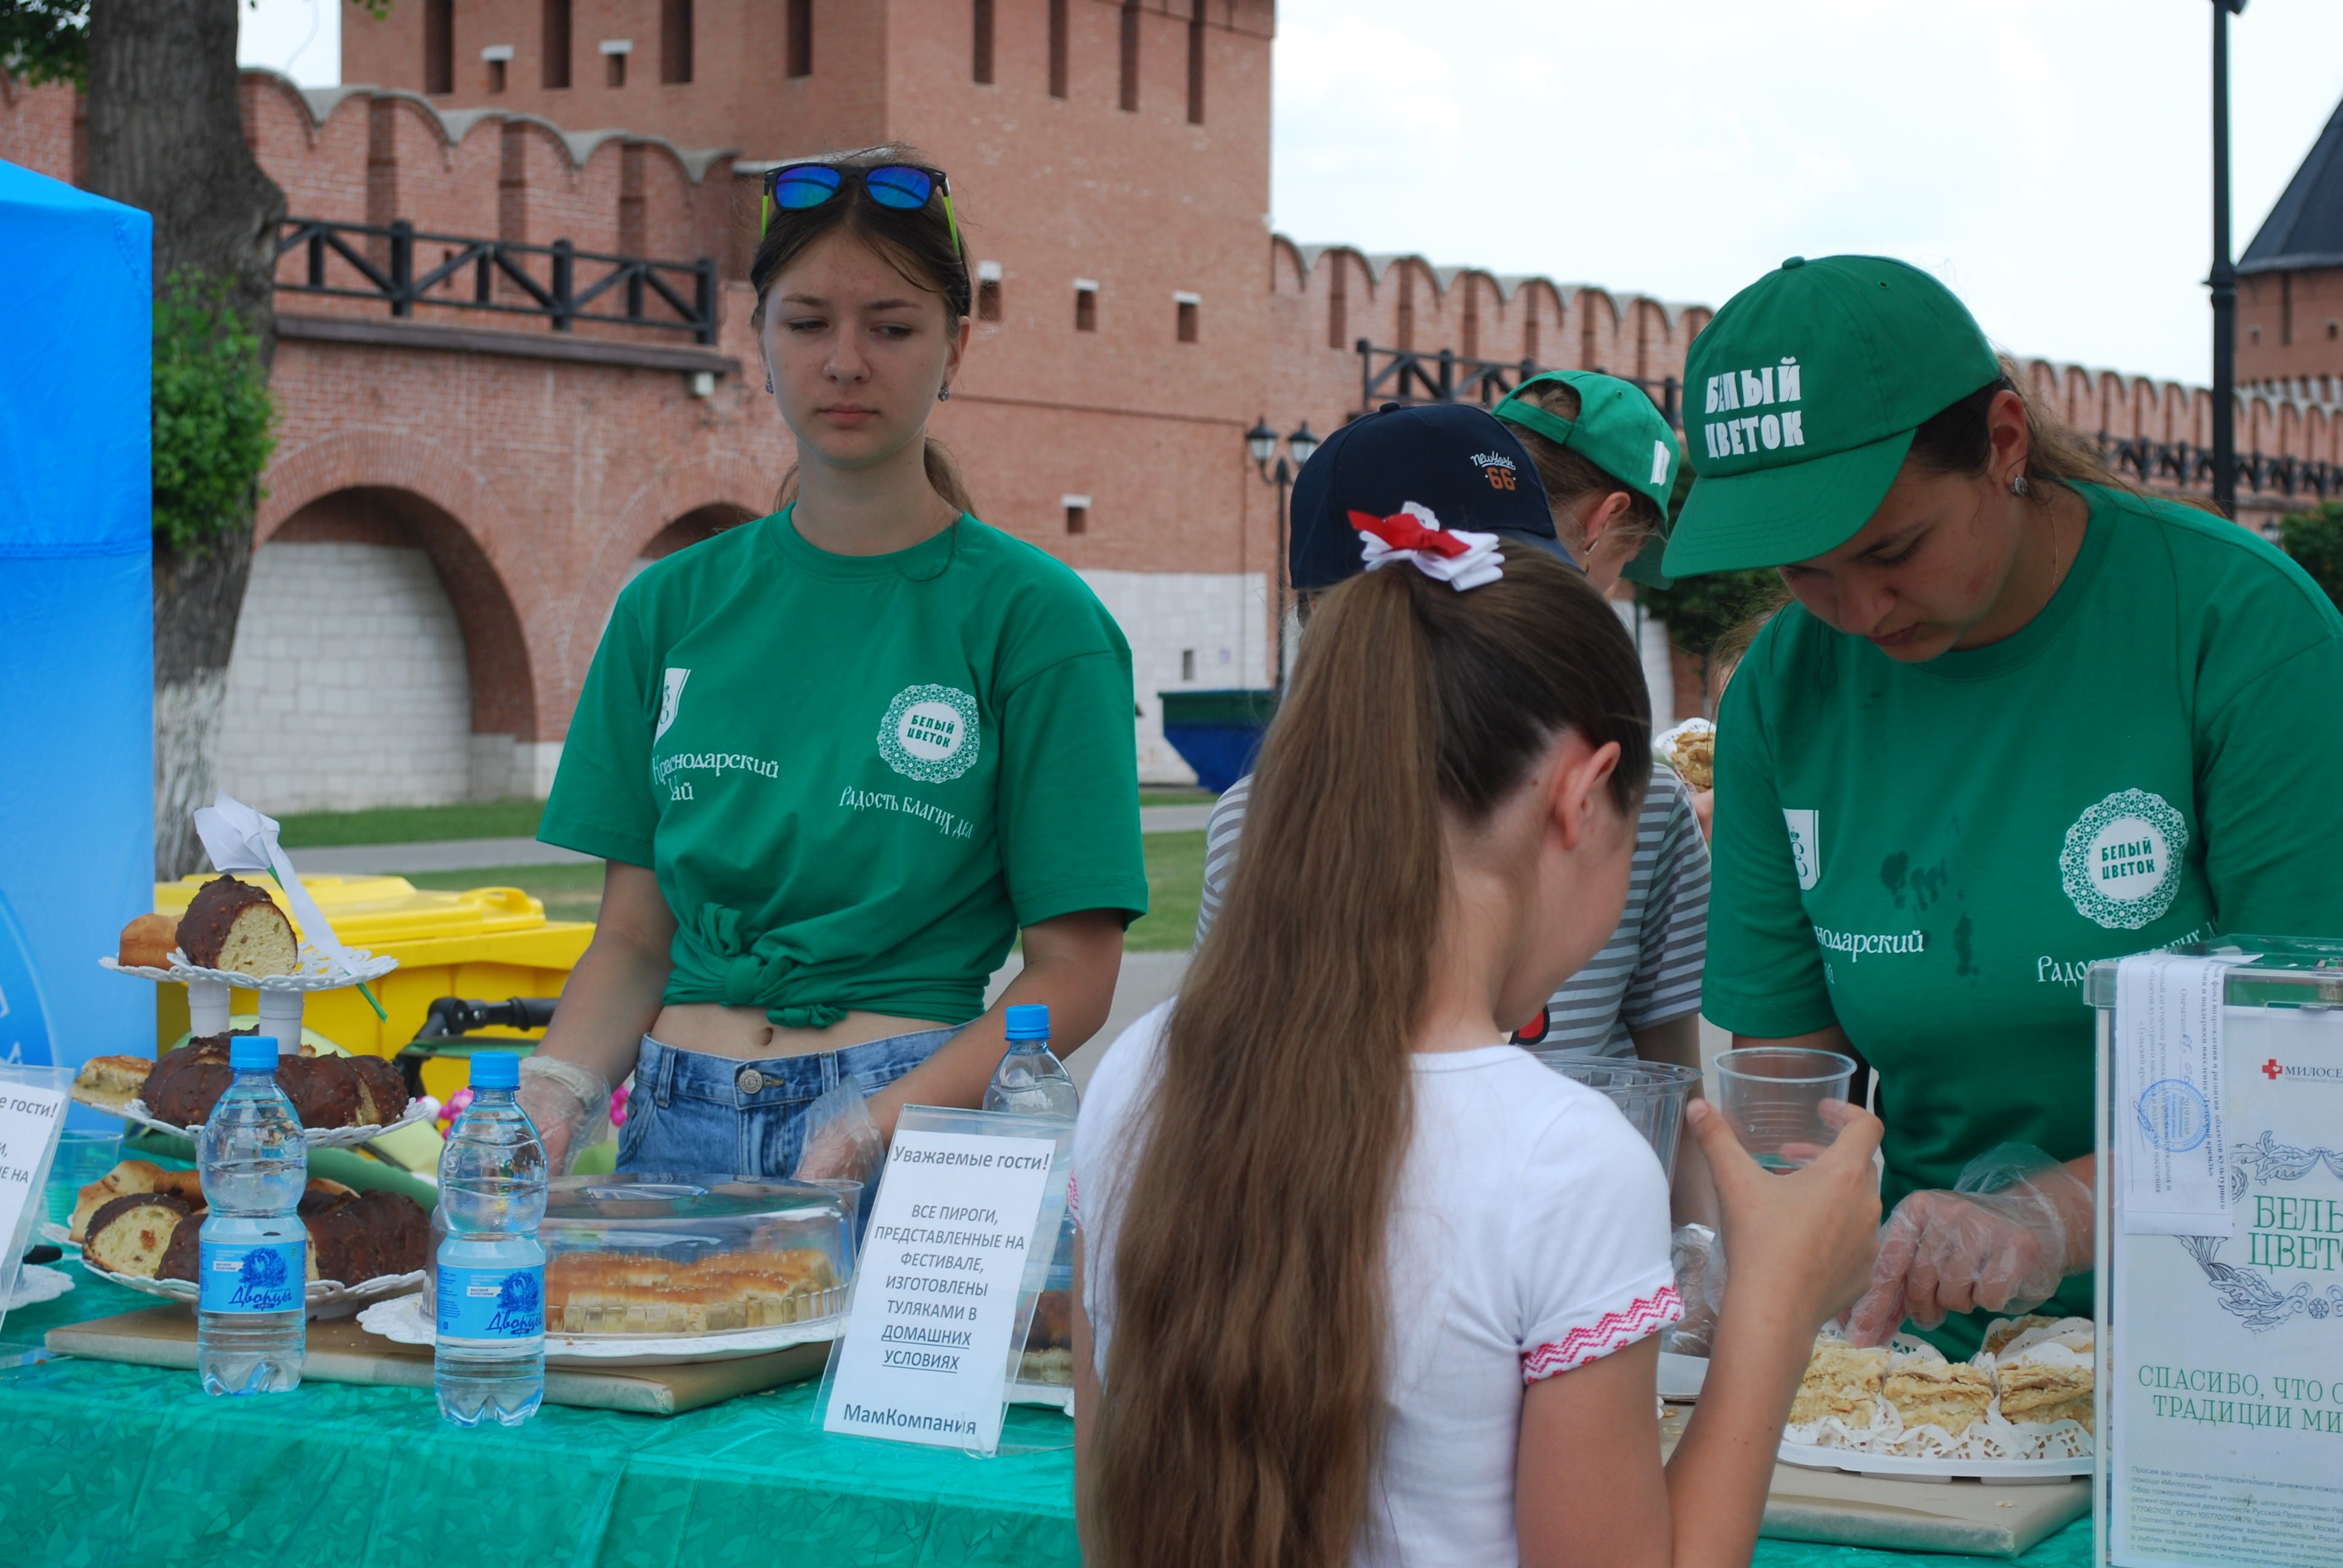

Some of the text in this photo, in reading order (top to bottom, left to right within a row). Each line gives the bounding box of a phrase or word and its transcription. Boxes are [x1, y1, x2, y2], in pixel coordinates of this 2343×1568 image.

[1705, 410, 1805, 460] ЦВЕТОК
[1486, 466, 1516, 491] 66
[911, 714, 955, 734] БЕЛЫЙ
[906, 727, 951, 748] ЦВЕТОК
[652, 753, 779, 786] Краснодарский
[2102, 836, 2152, 862] БЕЛЫЙ
[2102, 858, 2155, 880] ЦВЕТОК
[1814, 925, 1924, 963] нодарский
[2148, 969, 2157, 1005] объектов
[2160, 995, 2166, 1005] со
[2210, 980, 2221, 1002] фонд
[2158, 1006, 2166, 1040] стороны
[2180, 988, 2189, 1032] Опечатано
[2200, 996, 2209, 1044] поддержки
[2148, 1007, 2156, 1058] культурного
[2210, 1004, 2220, 1061] возрождения
[2212, 1071, 2220, 1111] развития
[10, 1099, 58, 1118] гости!
[2182, 1097, 2192, 1115] 2019
[2214, 1115, 2224, 1153] объектов
[892, 1145, 1050, 1172] Уважаемые гости!
[2204, 1141, 2215, 1177] кремль»
[11, 1168, 28, 1183] НА
[2154, 1152, 2162, 1193] населения
[2217, 1155, 2227, 1210] культурного
[911, 1204, 998, 1225] ВСЕ ПИРОГИ,
[874, 1225, 1025, 1250] ПРЕДСТАВЛЕННЫЕ НА
[900, 1252, 985, 1273] ФЕСТИВАЛЕ,
[2247, 1232, 2343, 1275] ЦВЕТ
[228, 1284, 293, 1312] Дворцы
[884, 1275, 989, 1296] ИЗГОТОВЛЕНЫ
[887, 1299, 978, 1321] ТУЛЯКАМИ В
[882, 1324, 972, 1347] ДОМАШНИХ
[883, 1350, 961, 1370] УСЛОВИЯХ
[2138, 1365, 2265, 1400] СПАСИБО,
[2273, 1376, 2323, 1402] ЧТО
[842, 1402, 977, 1436] МамКомпания
[2153, 1394, 2292, 1431] ТРАДИЦИИ
[2131, 1466, 2158, 1474] Просим
[2175, 1471, 2203, 1480] сделать
[2205, 1474, 2275, 1486] благотворительное
[2276, 1482, 2313, 1491] денежное
[2131, 1477, 2159, 1485] помощи
[2131, 1485, 2150, 1494] Сбор
[2152, 1488, 2207, 1499] пожертвований
[2279, 1501, 2329, 1512] осуществляет
[2131, 1496, 2158, 1504] держки
[2158, 1499, 2201, 1509] социальной
[2202, 1503, 2250, 1514] деятельности
[2252, 1507, 2281, 1517] Русской
[2282, 1511, 2335, 1523] Православной
[2139, 1517, 2186, 1526] соответствии
[2194, 1522, 2244, 1533] действующим
[2246, 1528, 2316, 1540] законодательством
[2176, 1509, 2197, 1518] ОГРН
[2313, 1524, 2341, 1534] Москва
[2131, 1525, 2177, 1535] принимается
[2178, 1529, 2203, 1538] только
[2241, 1535, 2276, 1546] Внесение
[2137, 1544, 2189, 1555] предложением
[2220, 1553, 2290, 1566] благотворительное
[2138, 1535, 2163, 1544] рублях
[2164, 1538, 2197, 1547] является
[2198, 1542, 2259, 1554] подтверждением
[2261, 1549, 2289, 1557] вашего
[2290, 1552, 2343, 1563] ознакомления
